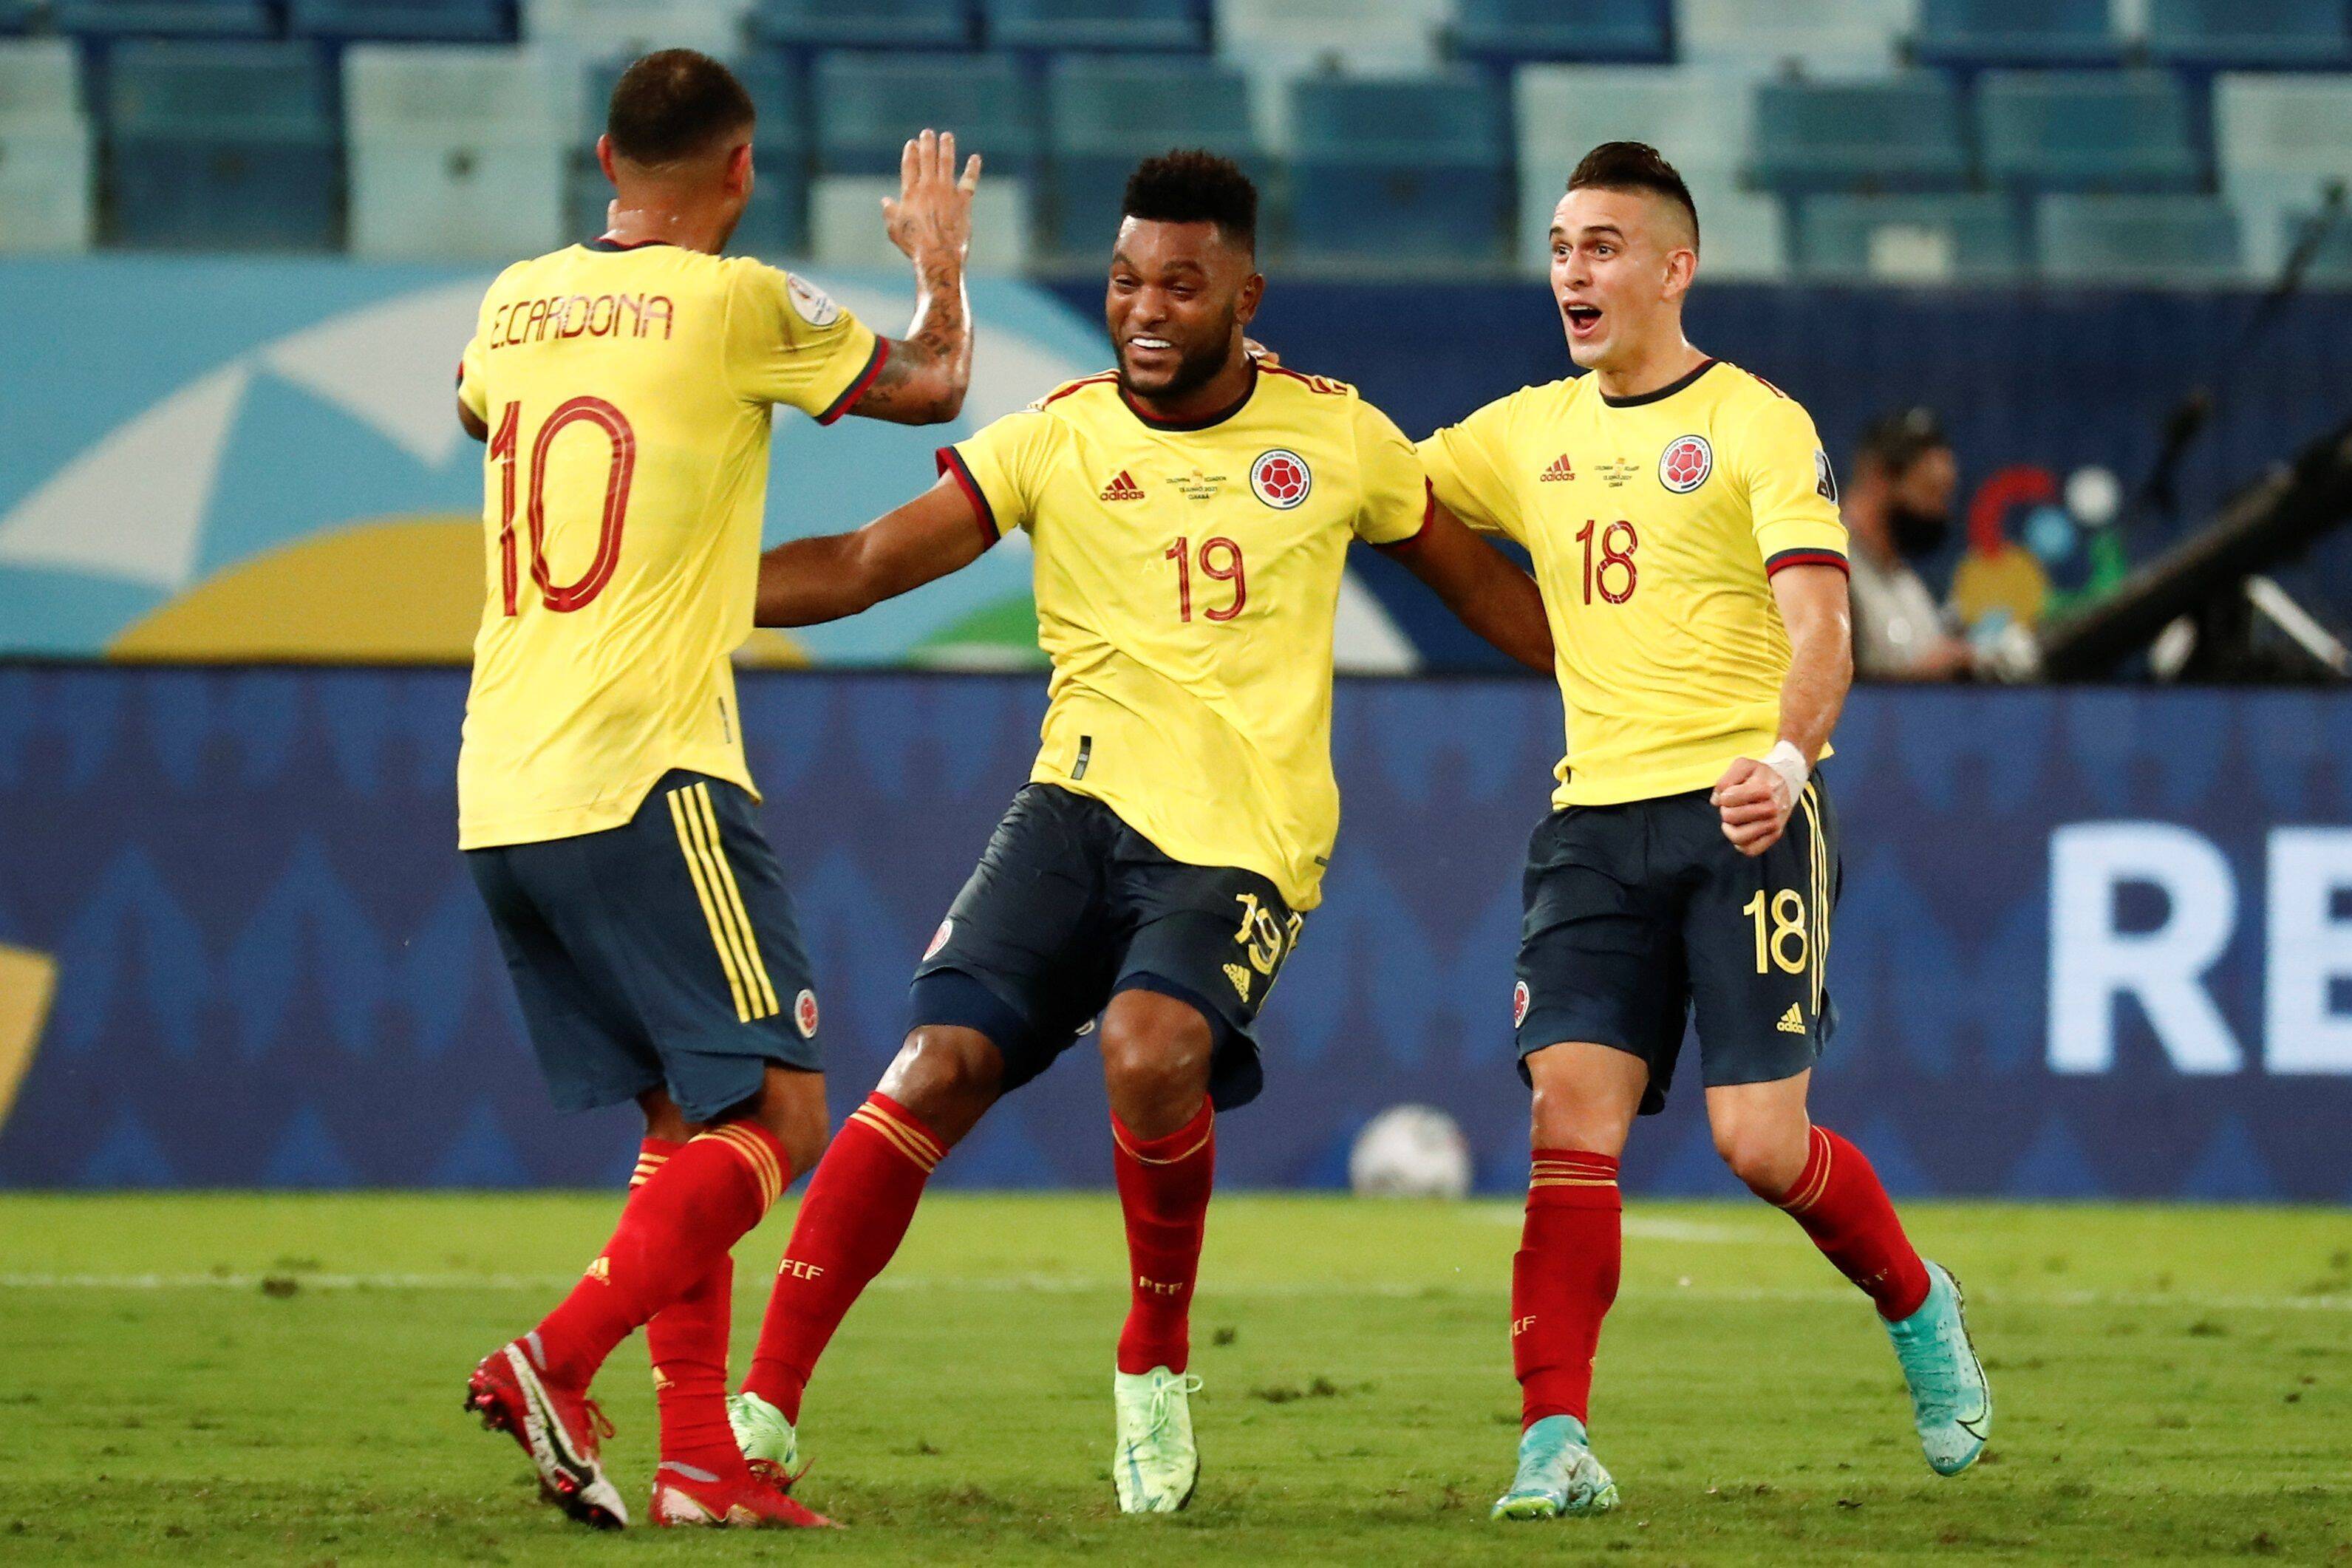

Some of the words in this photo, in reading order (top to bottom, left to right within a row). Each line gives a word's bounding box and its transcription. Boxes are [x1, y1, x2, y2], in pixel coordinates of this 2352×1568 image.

[491, 293, 674, 350] E.CARDONA
[490, 395, 635, 617] 10
[1100, 489, 1145, 501] adidas
[1540, 470, 1576, 483] adidas
[1165, 536, 1247, 623] 19
[1575, 519, 1638, 606] 18
[1235, 893, 1282, 975] 19
[1742, 888, 1808, 975] 18
[2045, 819, 2352, 1075] RE
[778, 1258, 825, 1281] FCF
